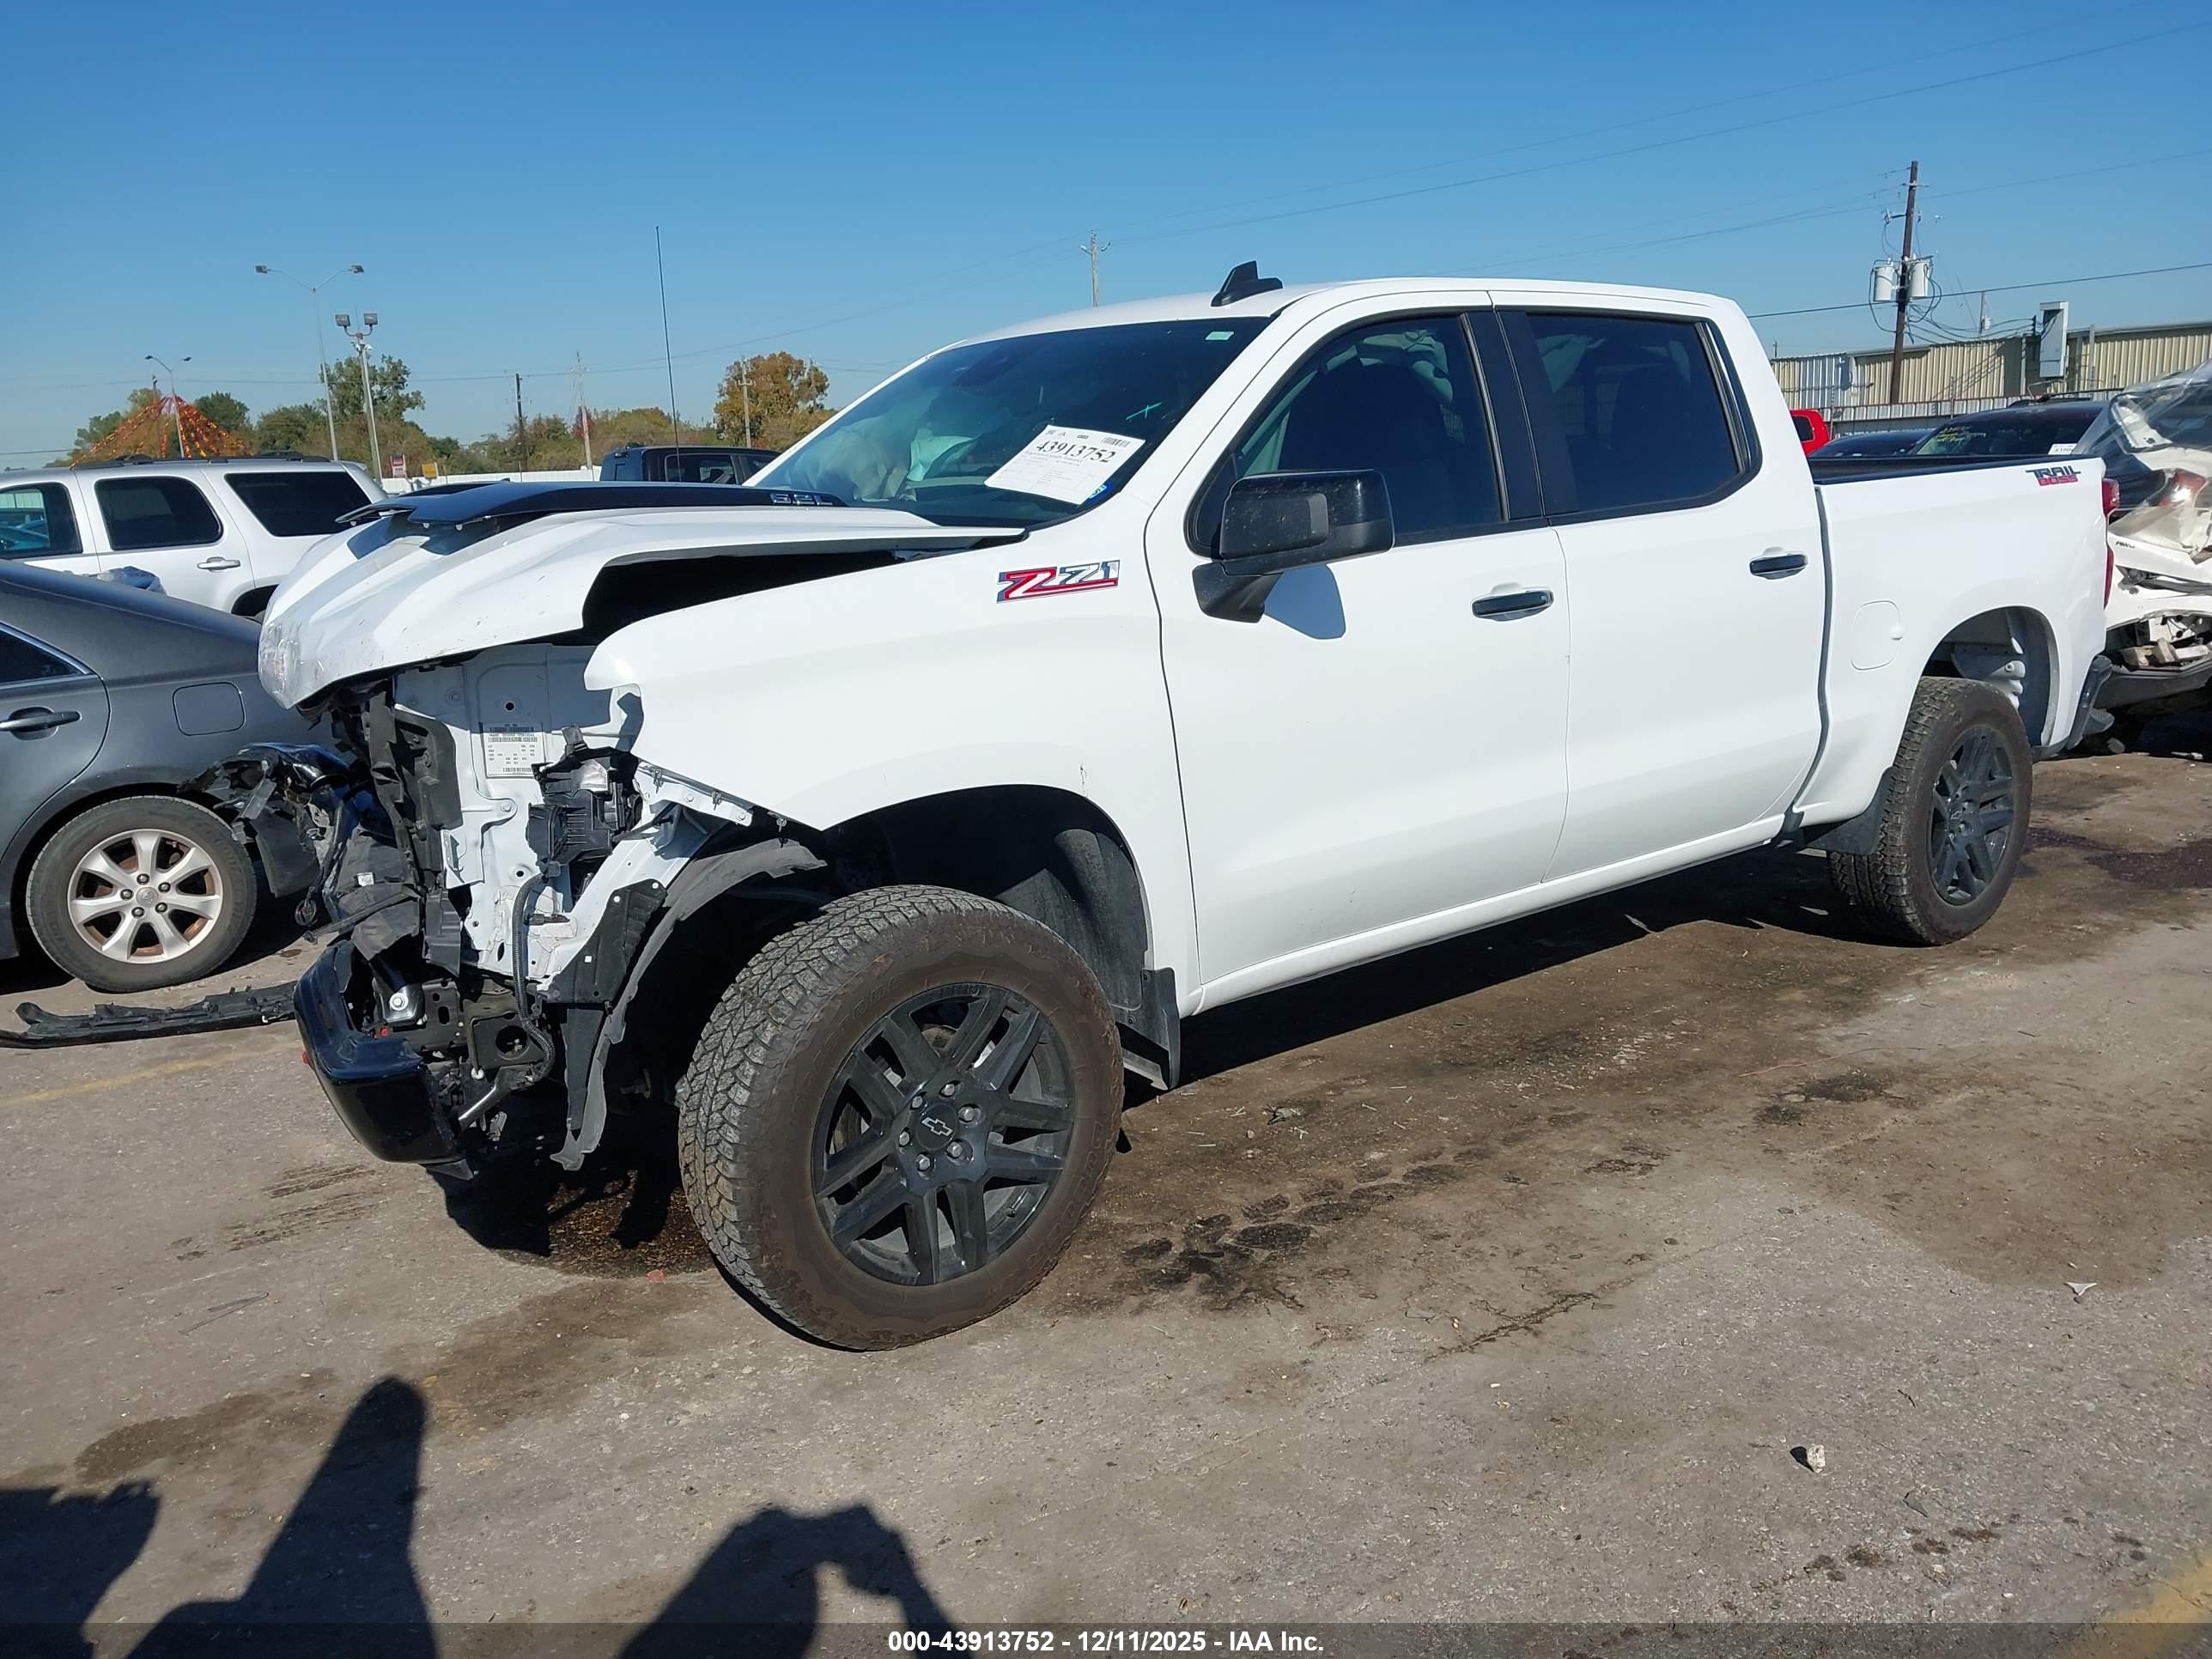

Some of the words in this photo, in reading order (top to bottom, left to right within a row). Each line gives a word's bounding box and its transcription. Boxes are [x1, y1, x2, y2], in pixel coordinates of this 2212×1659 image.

[1036, 441, 1116, 463] 43913752
[2025, 465, 2081, 478] TRAIL
[2038, 474, 2078, 487] BOSS
[996, 560, 1120, 604] Z71
